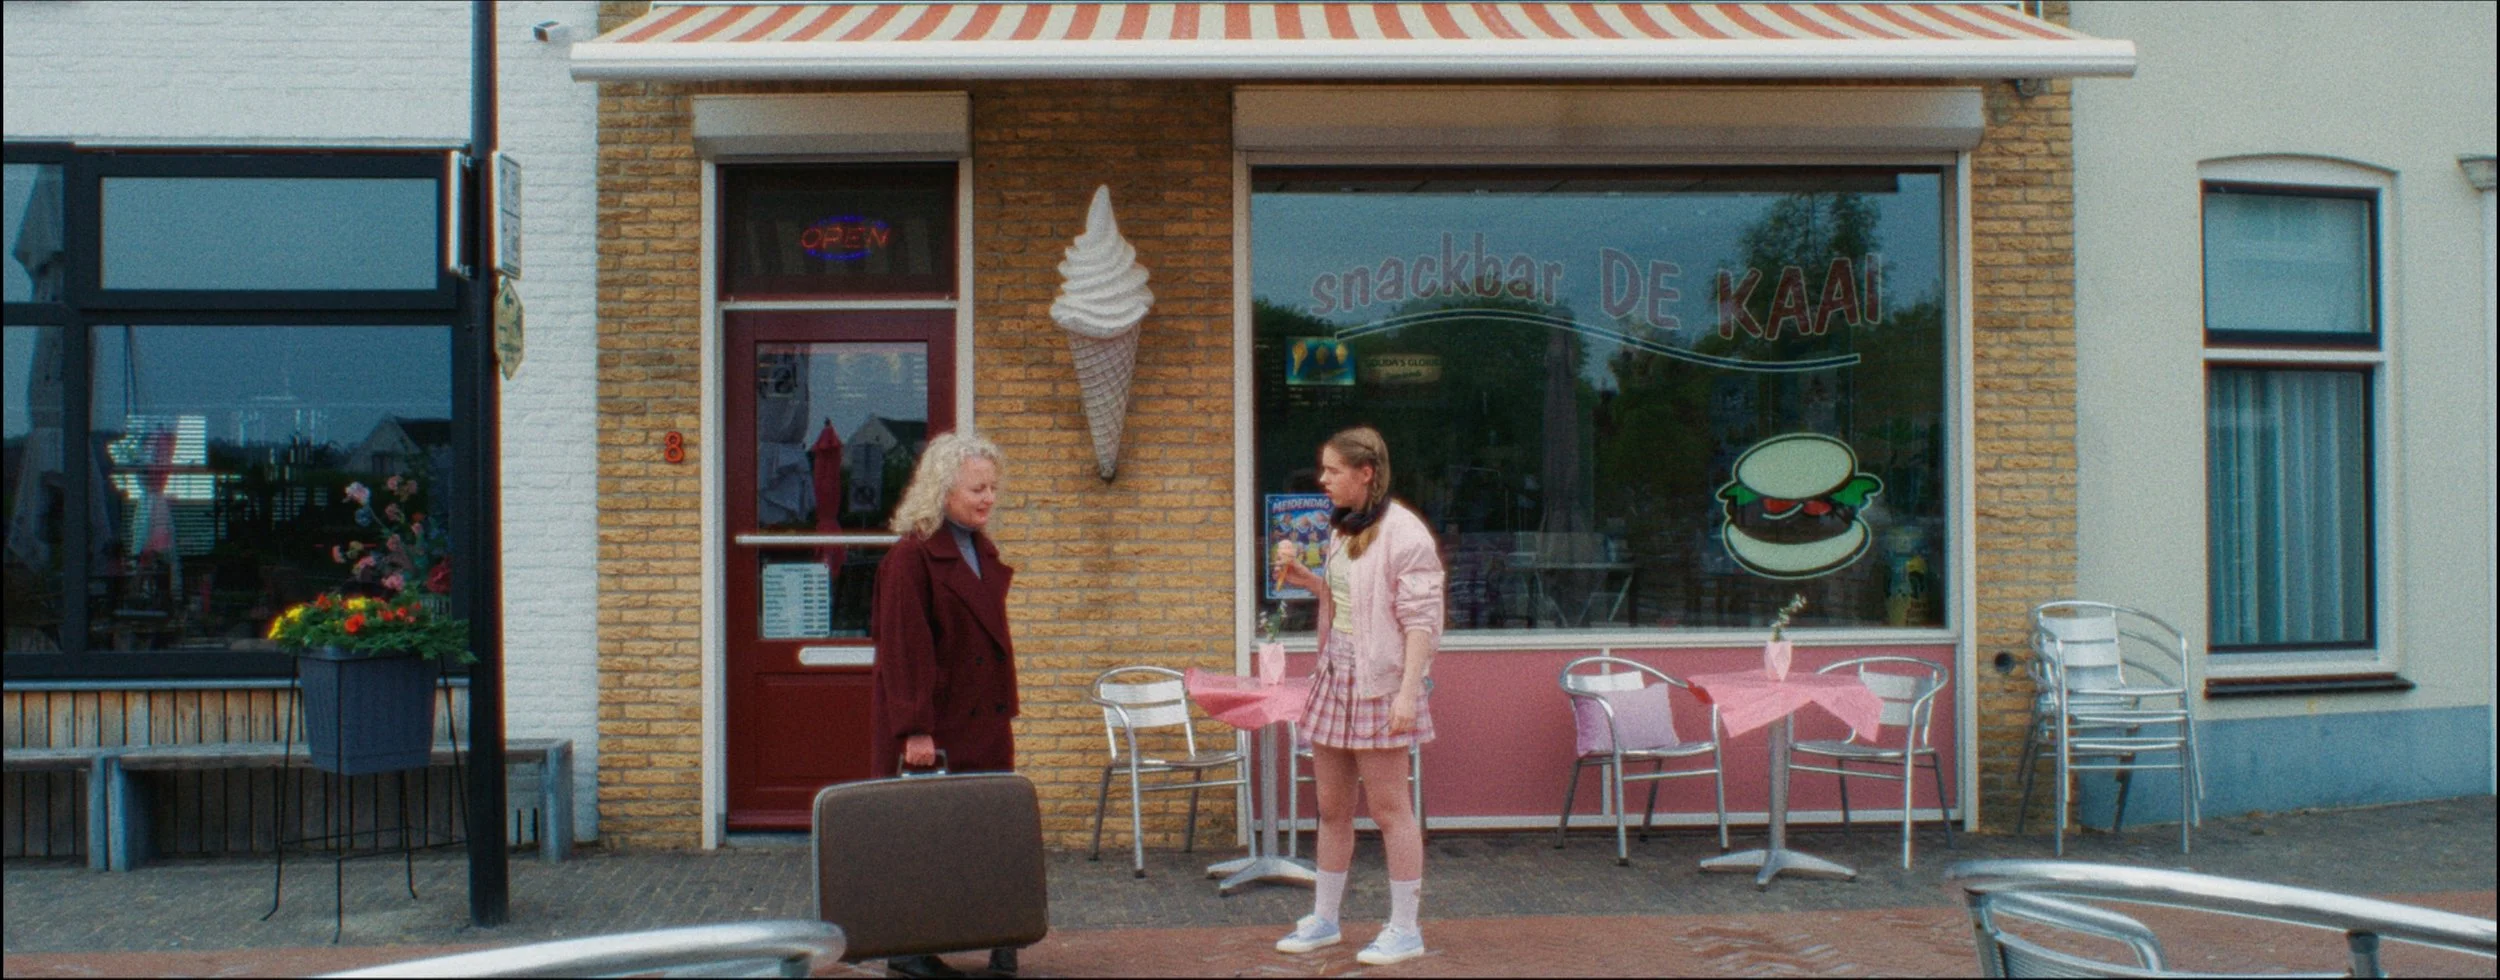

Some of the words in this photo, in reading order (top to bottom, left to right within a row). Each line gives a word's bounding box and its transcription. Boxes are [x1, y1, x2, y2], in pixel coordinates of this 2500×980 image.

[801, 224, 889, 249] OPEN
[1311, 231, 1564, 316] snackbar
[1600, 246, 1681, 330] DE
[1717, 252, 1881, 341] KAAI
[664, 431, 684, 464] 8
